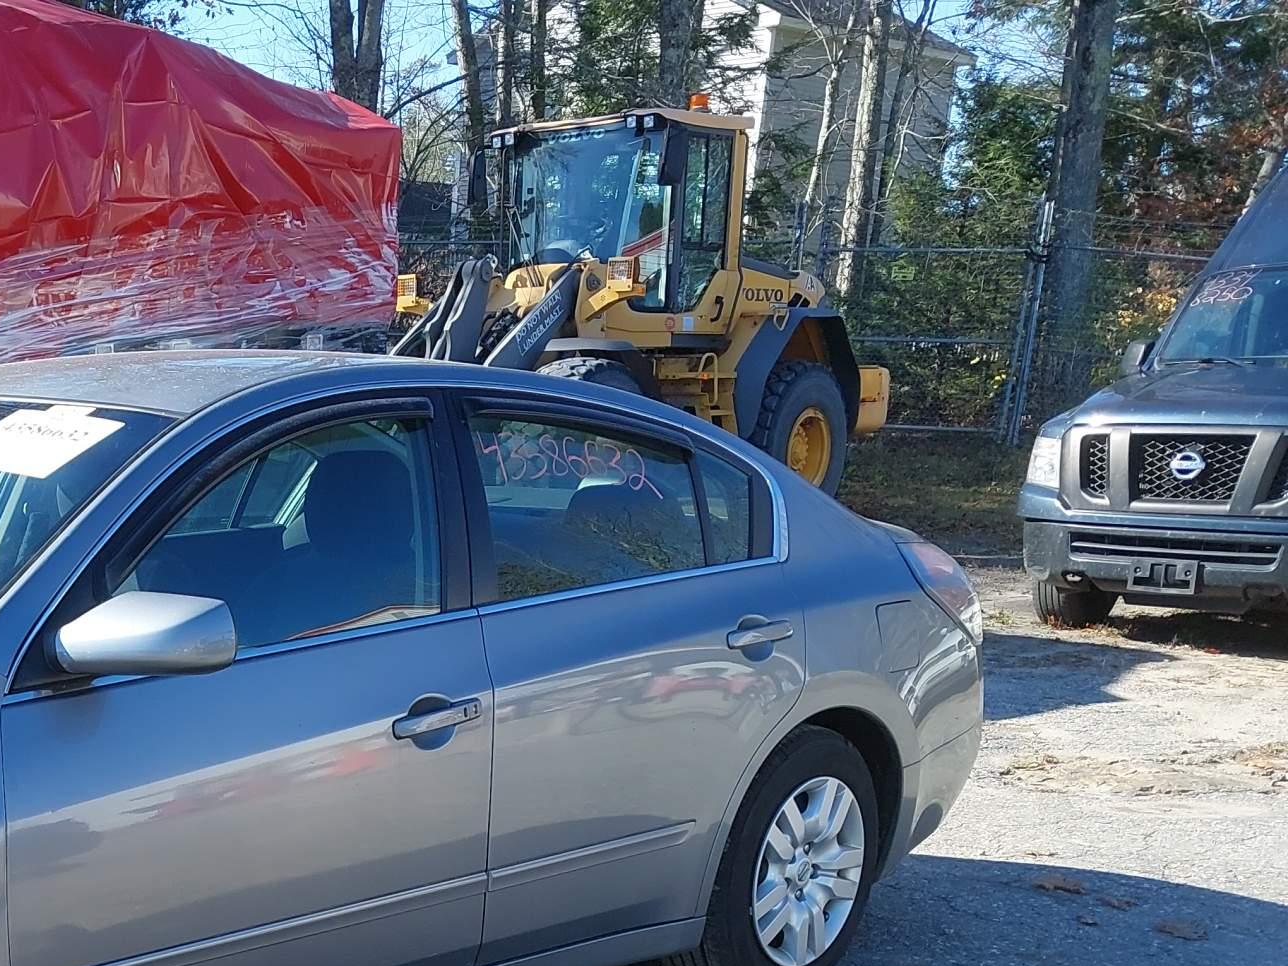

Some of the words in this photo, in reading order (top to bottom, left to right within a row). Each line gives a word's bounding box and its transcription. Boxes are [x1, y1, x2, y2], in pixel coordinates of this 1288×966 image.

[548, 128, 606, 145] VOLVO
[743, 287, 784, 302] OLVO
[515, 327, 527, 342] DO
[527, 311, 541, 331] NOT
[523, 325, 545, 350] UNDER
[476, 431, 664, 500] 43586632
